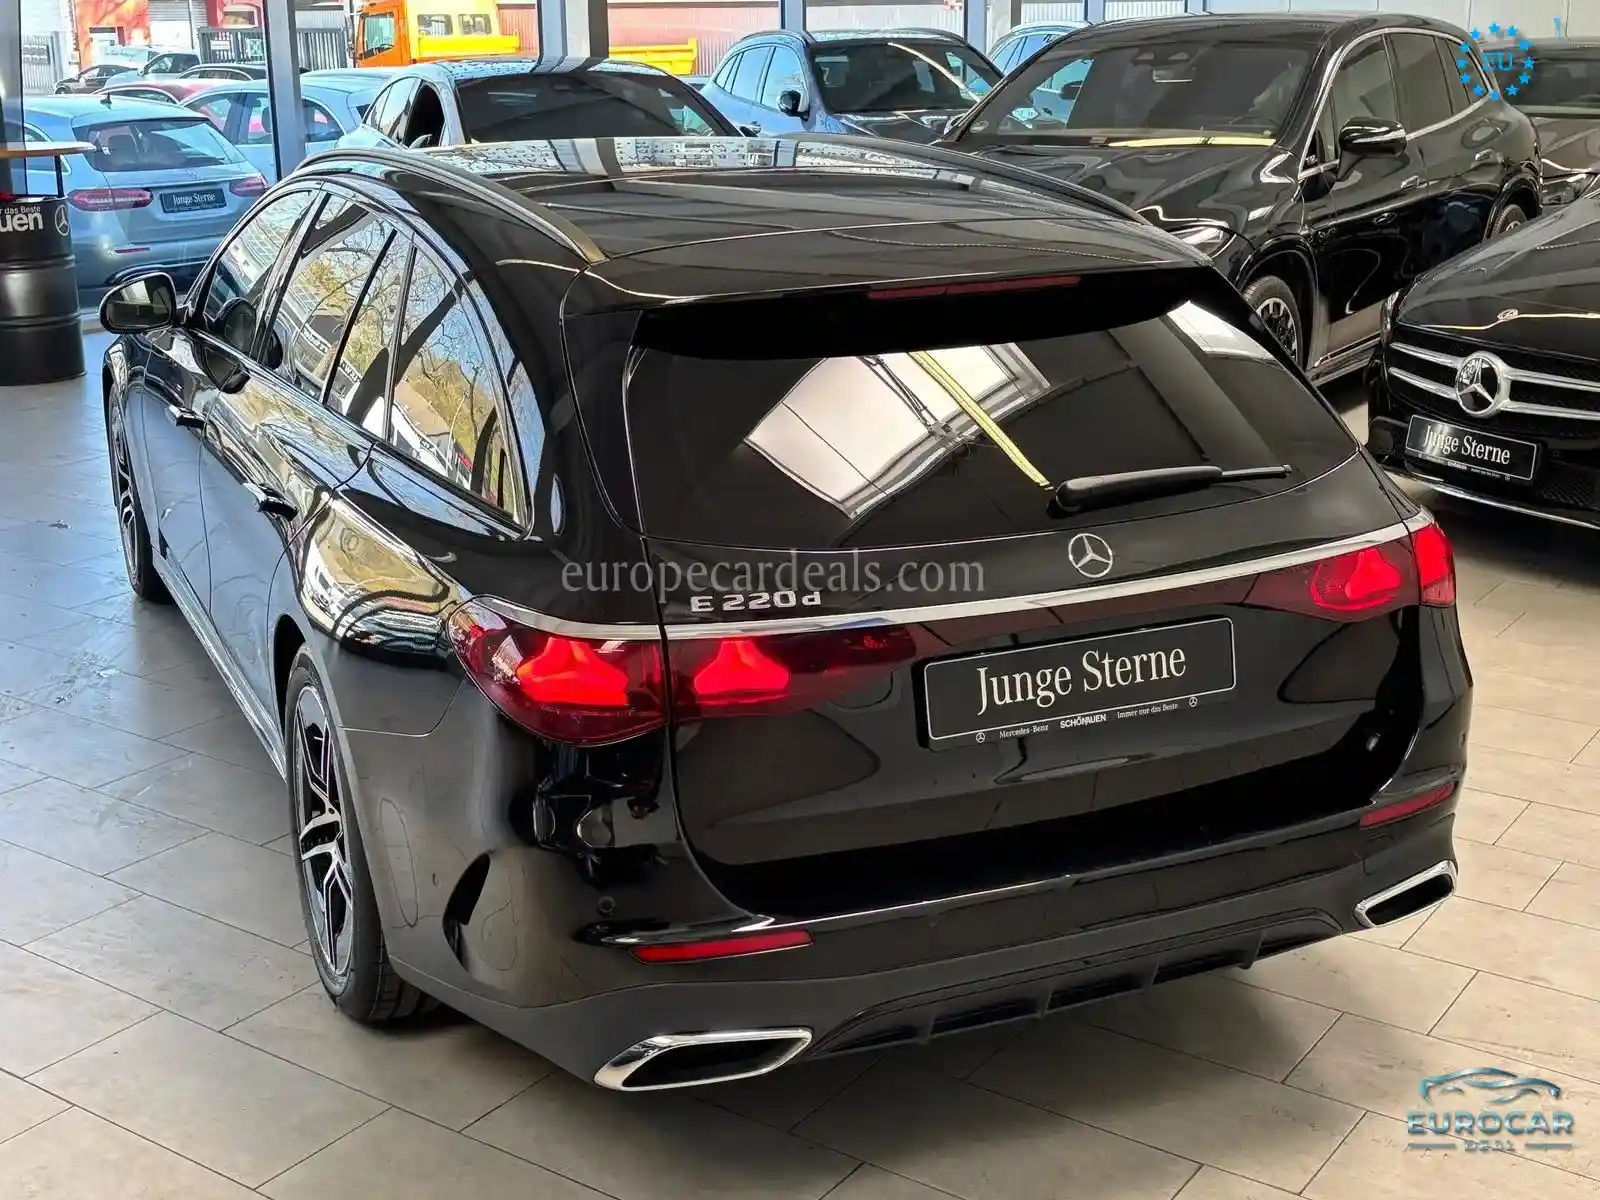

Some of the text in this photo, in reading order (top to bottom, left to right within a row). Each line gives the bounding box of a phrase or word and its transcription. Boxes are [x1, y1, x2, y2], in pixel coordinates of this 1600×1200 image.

[20, 205, 41, 214] Beste
[1423, 425, 1511, 464] Junge Sterne
[690, 595, 714, 612] E
[976, 648, 1186, 716] Junge Sterne
[1117, 709, 1138, 719] Immer
[1138, 706, 1150, 715] nur
[1150, 704, 1162, 713] das
[1162, 703, 1179, 712] Beste
